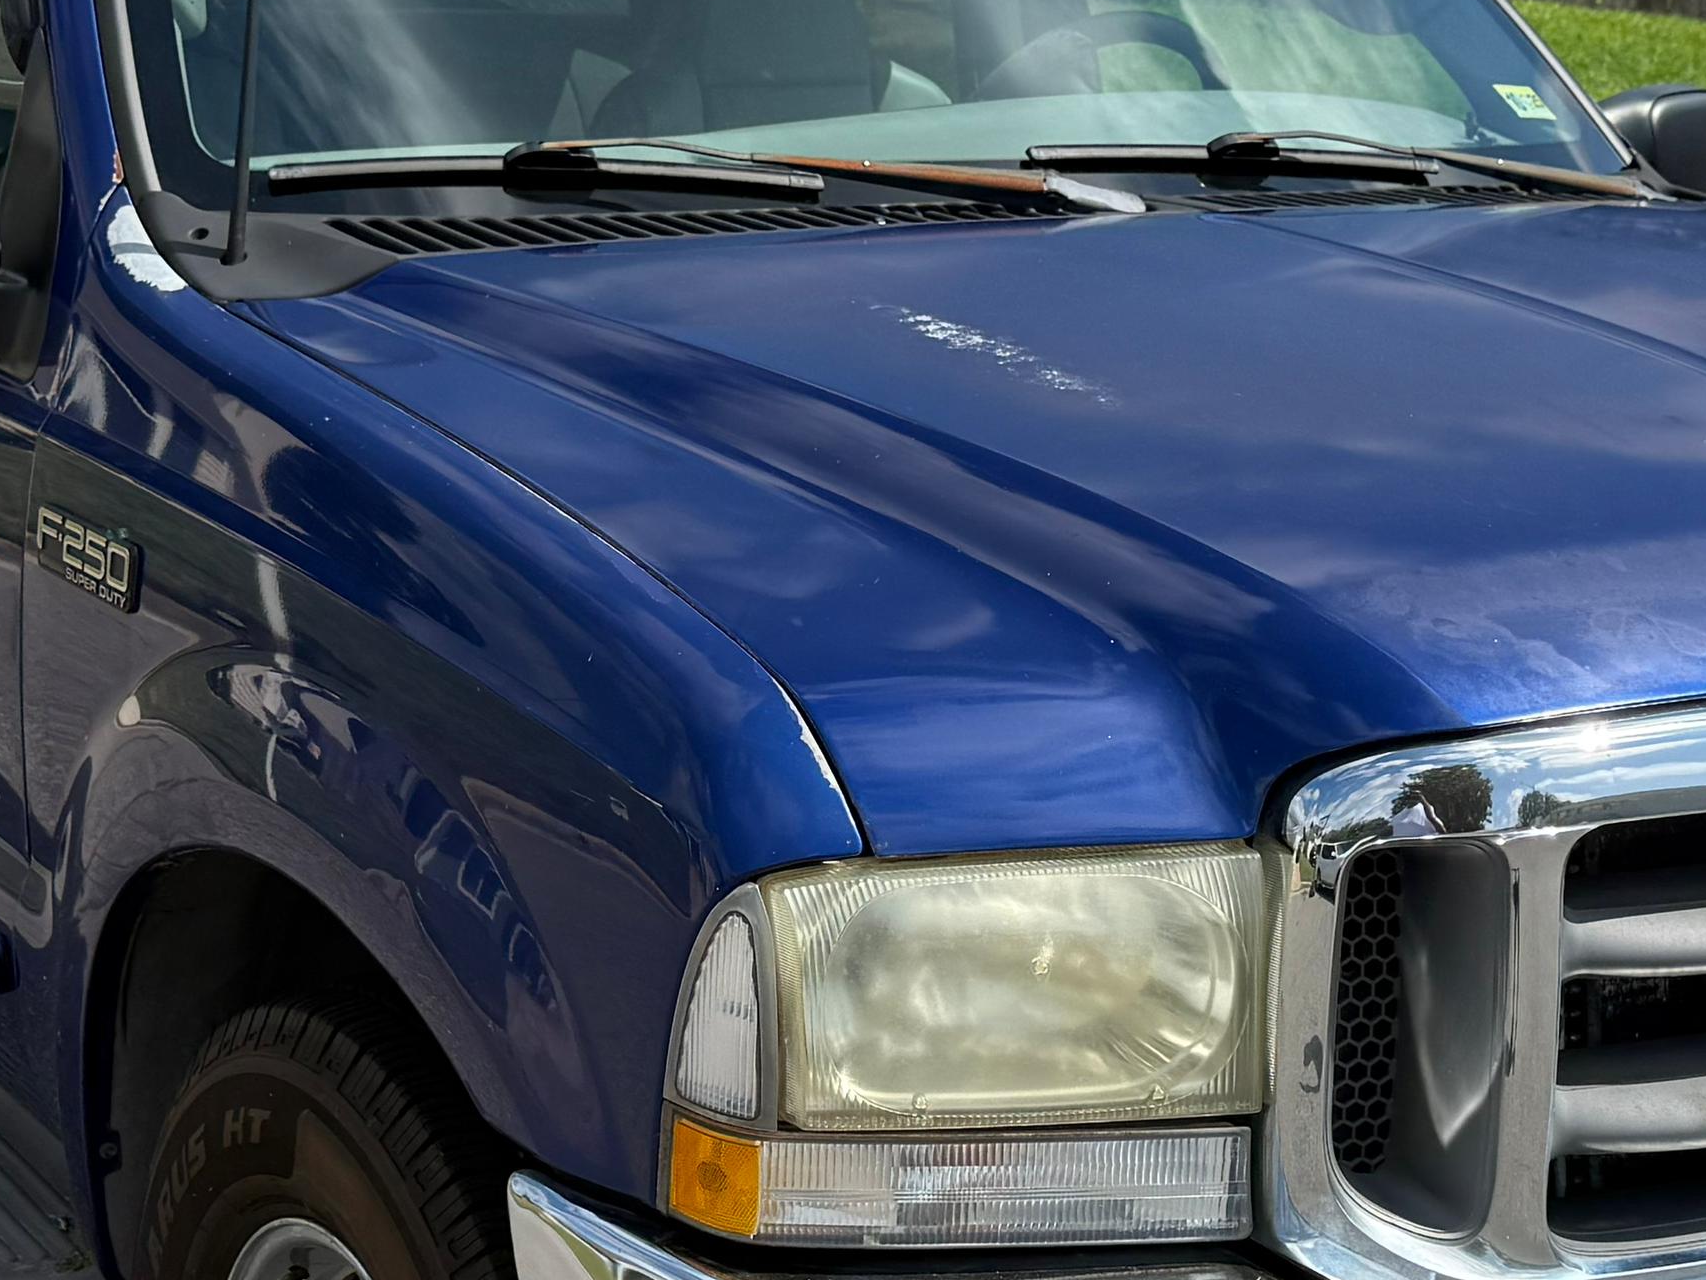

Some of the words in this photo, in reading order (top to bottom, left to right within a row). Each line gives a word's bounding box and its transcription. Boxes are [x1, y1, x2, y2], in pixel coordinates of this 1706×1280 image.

[64, 567, 98, 594] SUPER
[98, 585, 127, 609] DUTY
[222, 1104, 272, 1148] HT
